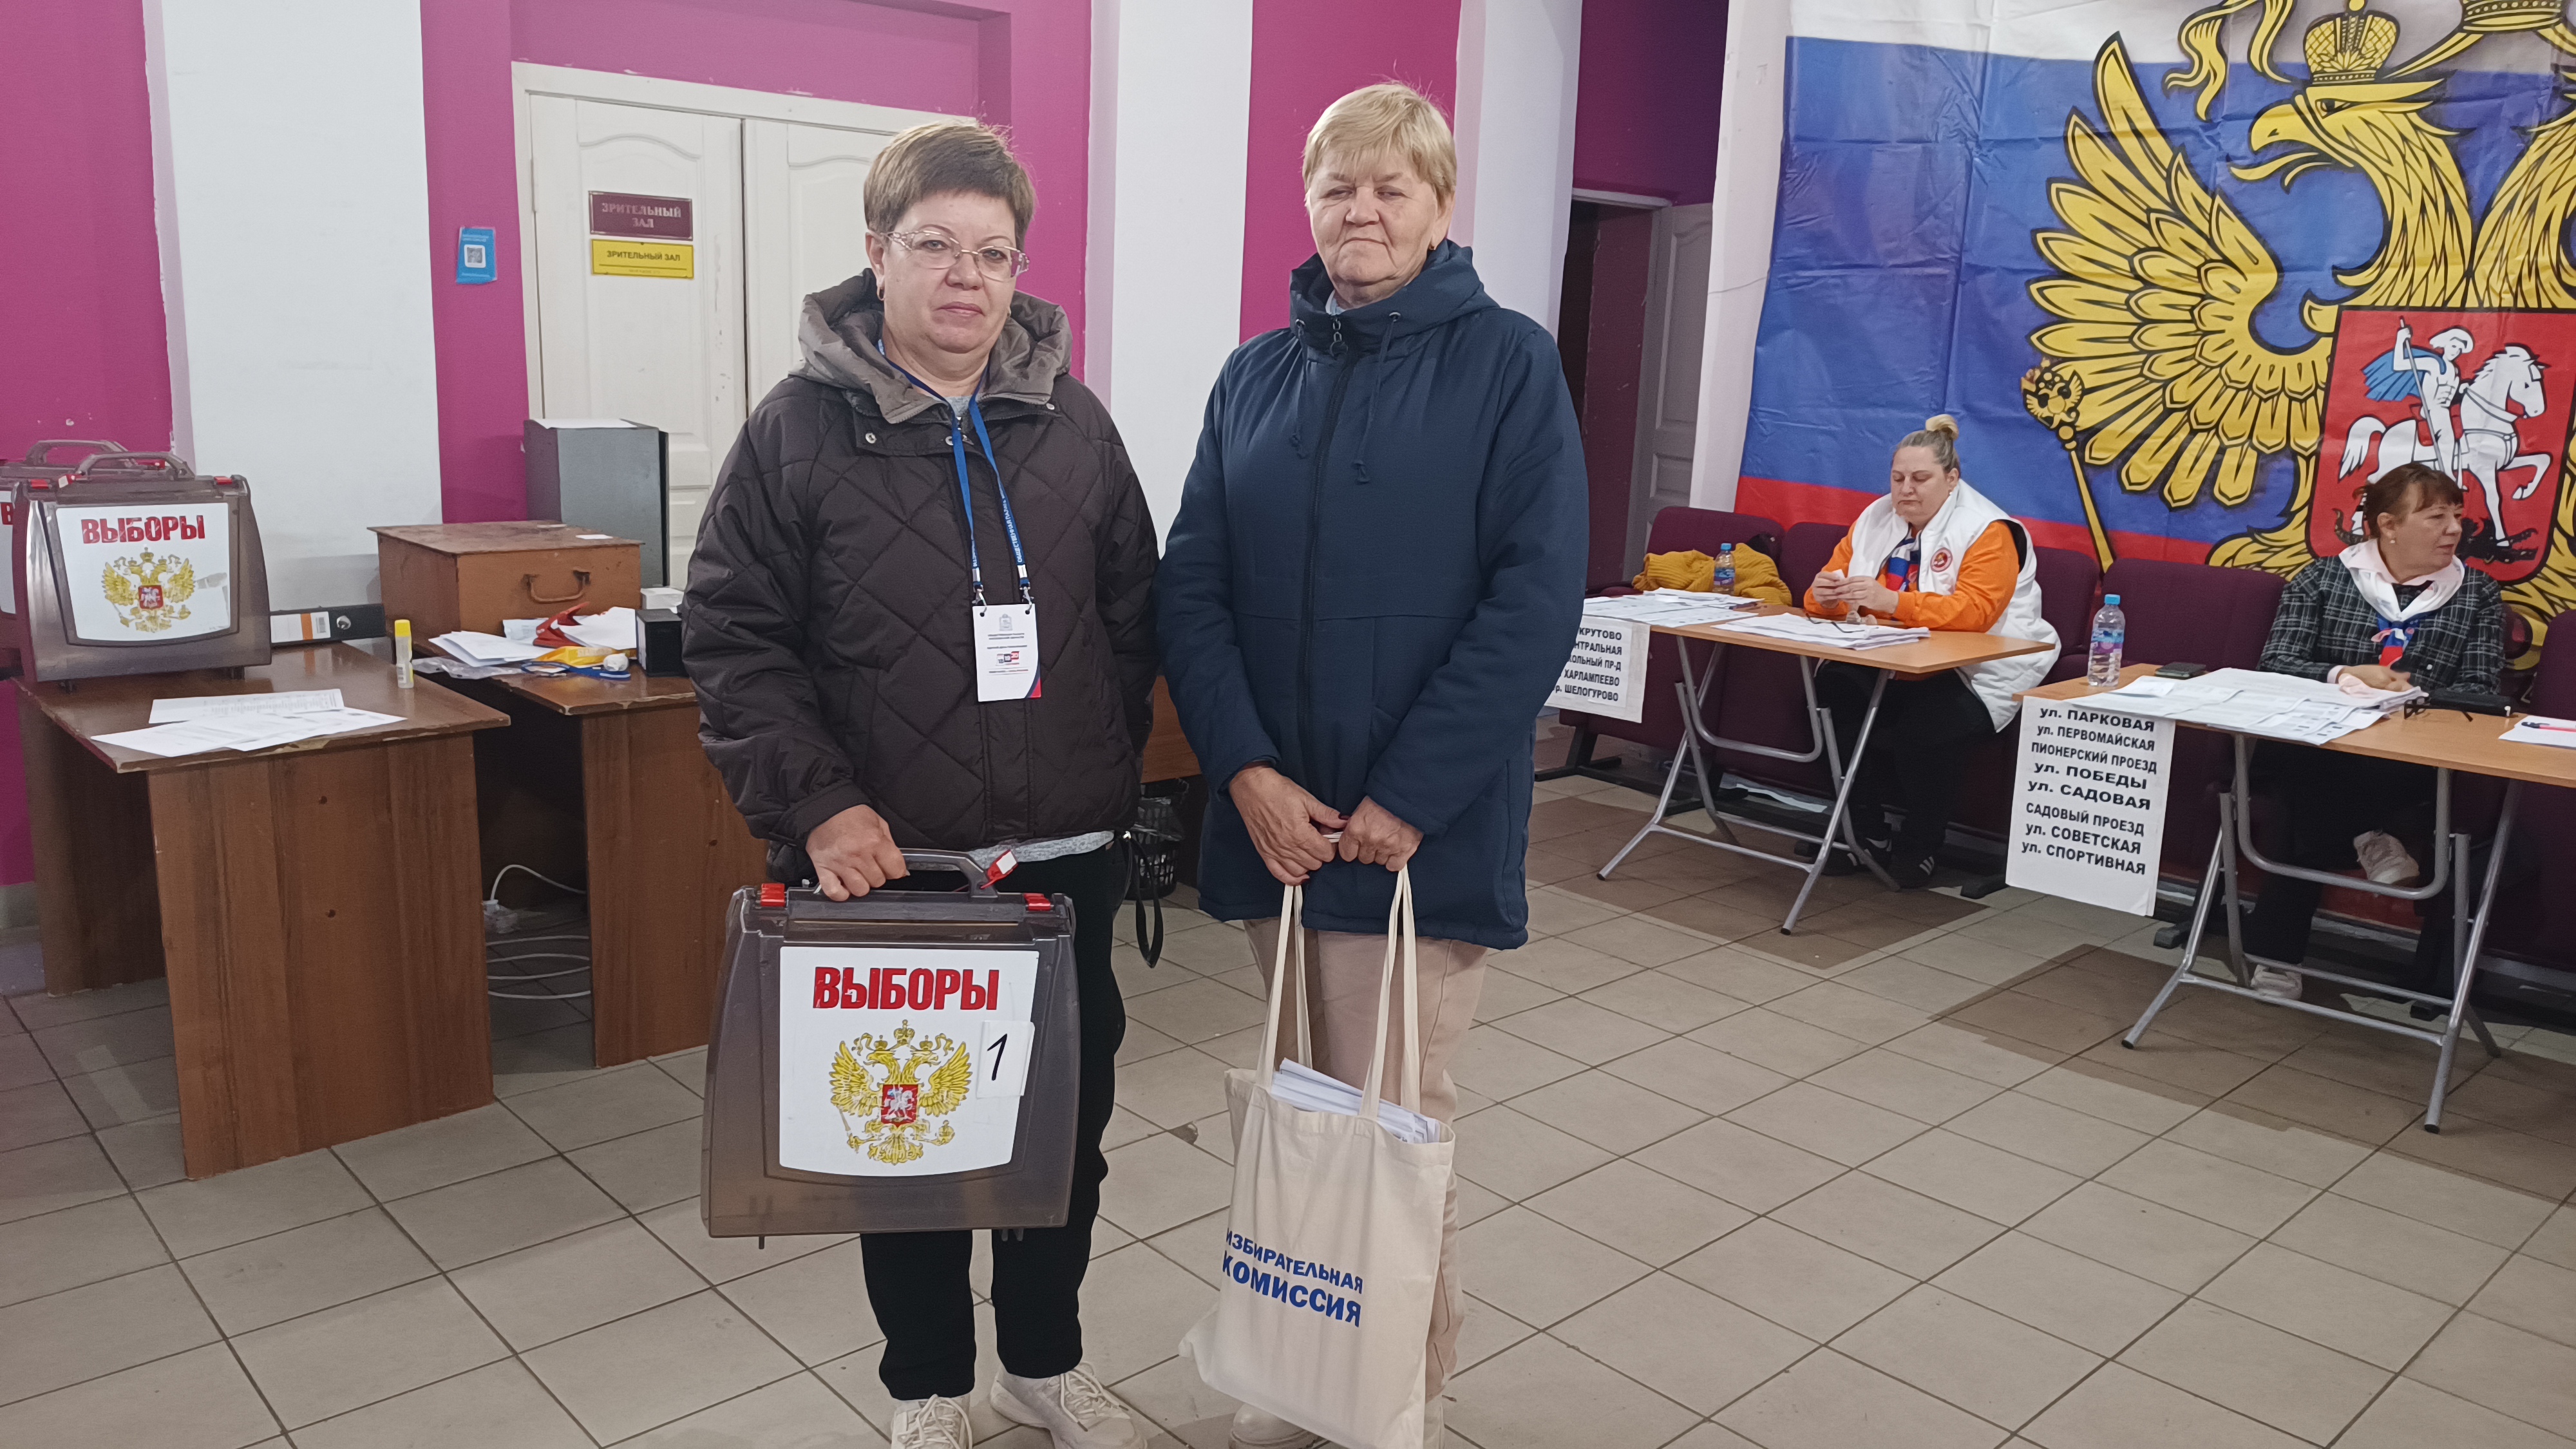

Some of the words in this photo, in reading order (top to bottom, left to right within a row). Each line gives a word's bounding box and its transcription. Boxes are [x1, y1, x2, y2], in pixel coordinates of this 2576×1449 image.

[602, 202, 681, 218] ЗРИТЕЛЬНЫЙ
[632, 218, 654, 228] ЗАЛ
[607, 250, 663, 260] ЗРИТЕЛЬНЫЙ
[81, 515, 205, 544] ВЫБОРЫ
[1575, 641, 1622, 655] НТРАЛЬНАЯ
[1564, 668, 1620, 687] ХАРЛАМПЕЕВО
[1604, 659, 1622, 672] ПР-Д
[1564, 684, 1618, 701] ШЕЛОГУРОВО
[2039, 708, 2062, 719] ул.
[2067, 709, 2155, 732] ПАРКОВАЯ
[2037, 725, 2054, 736] ул.
[2057, 726, 2155, 752] ПЕРВОМАЙСКАЯ
[2031, 742, 2108, 764] ПИОНЕРСКИЙ
[2111, 755, 2157, 775] ПРОЕЗД
[2034, 762, 2060, 774] ул.
[2066, 766, 2147, 790] ПОБЕДЫ
[2027, 781, 2054, 792] ул.
[2060, 784, 2150, 810] САДОВАЯ
[2026, 802, 2089, 824] САДОВЫЙ
[2093, 815, 2145, 837] ПРОЕЗД
[2025, 823, 2046, 835] ул.
[2051, 826, 2141, 855] СОВЕТСКАЯ
[2022, 841, 2042, 854] ул.
[2046, 844, 2146, 875] СПОРТИВНАЯ
[813, 966, 999, 1010] ВЫБОРЫ
[987, 1033, 1008, 1081] 1
[1226, 1227, 1363, 1294] ИЗБИРАТЕЛЬНАЯ
[1222, 1250, 1362, 1327] КОМИССИЯ
